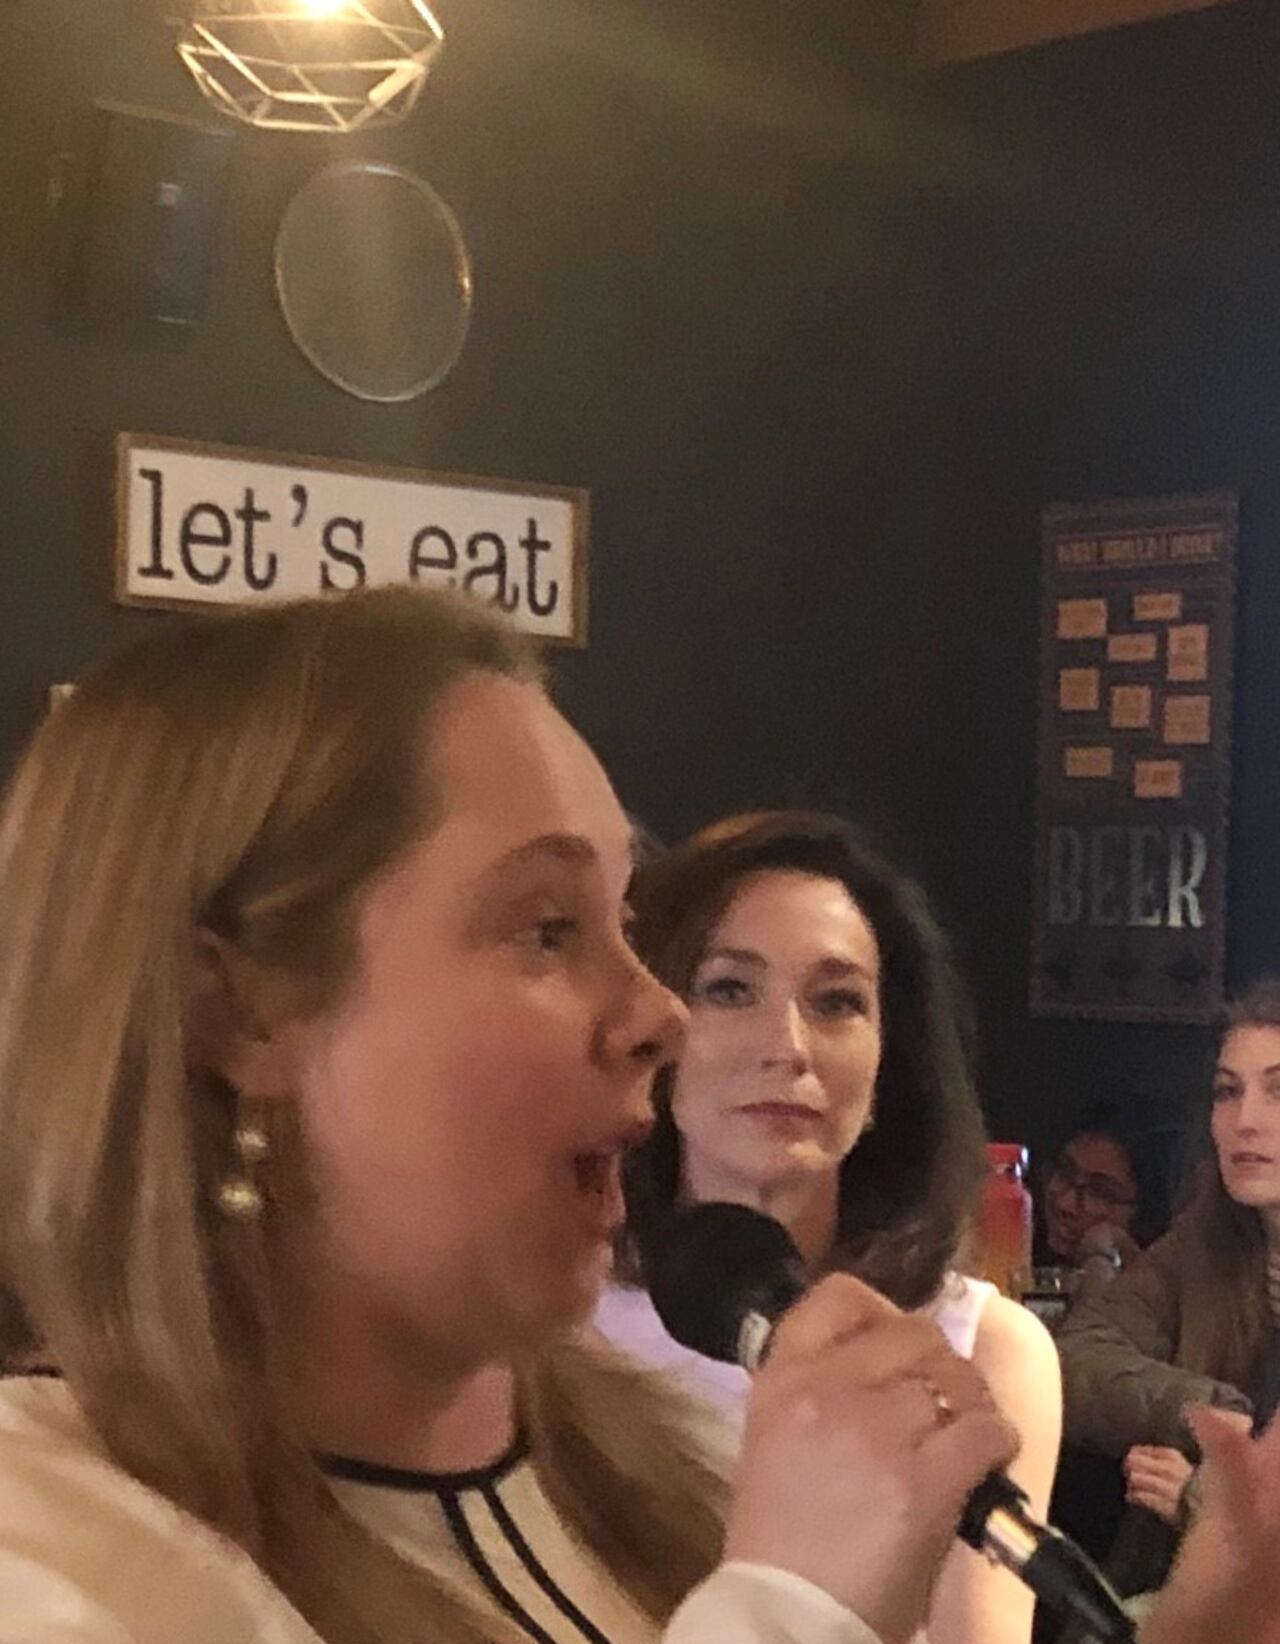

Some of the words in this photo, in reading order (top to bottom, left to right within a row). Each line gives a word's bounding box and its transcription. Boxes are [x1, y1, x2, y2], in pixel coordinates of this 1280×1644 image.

[138, 469, 367, 591] let's
[410, 518, 559, 617] eat
[1048, 823, 1208, 928] BEER
